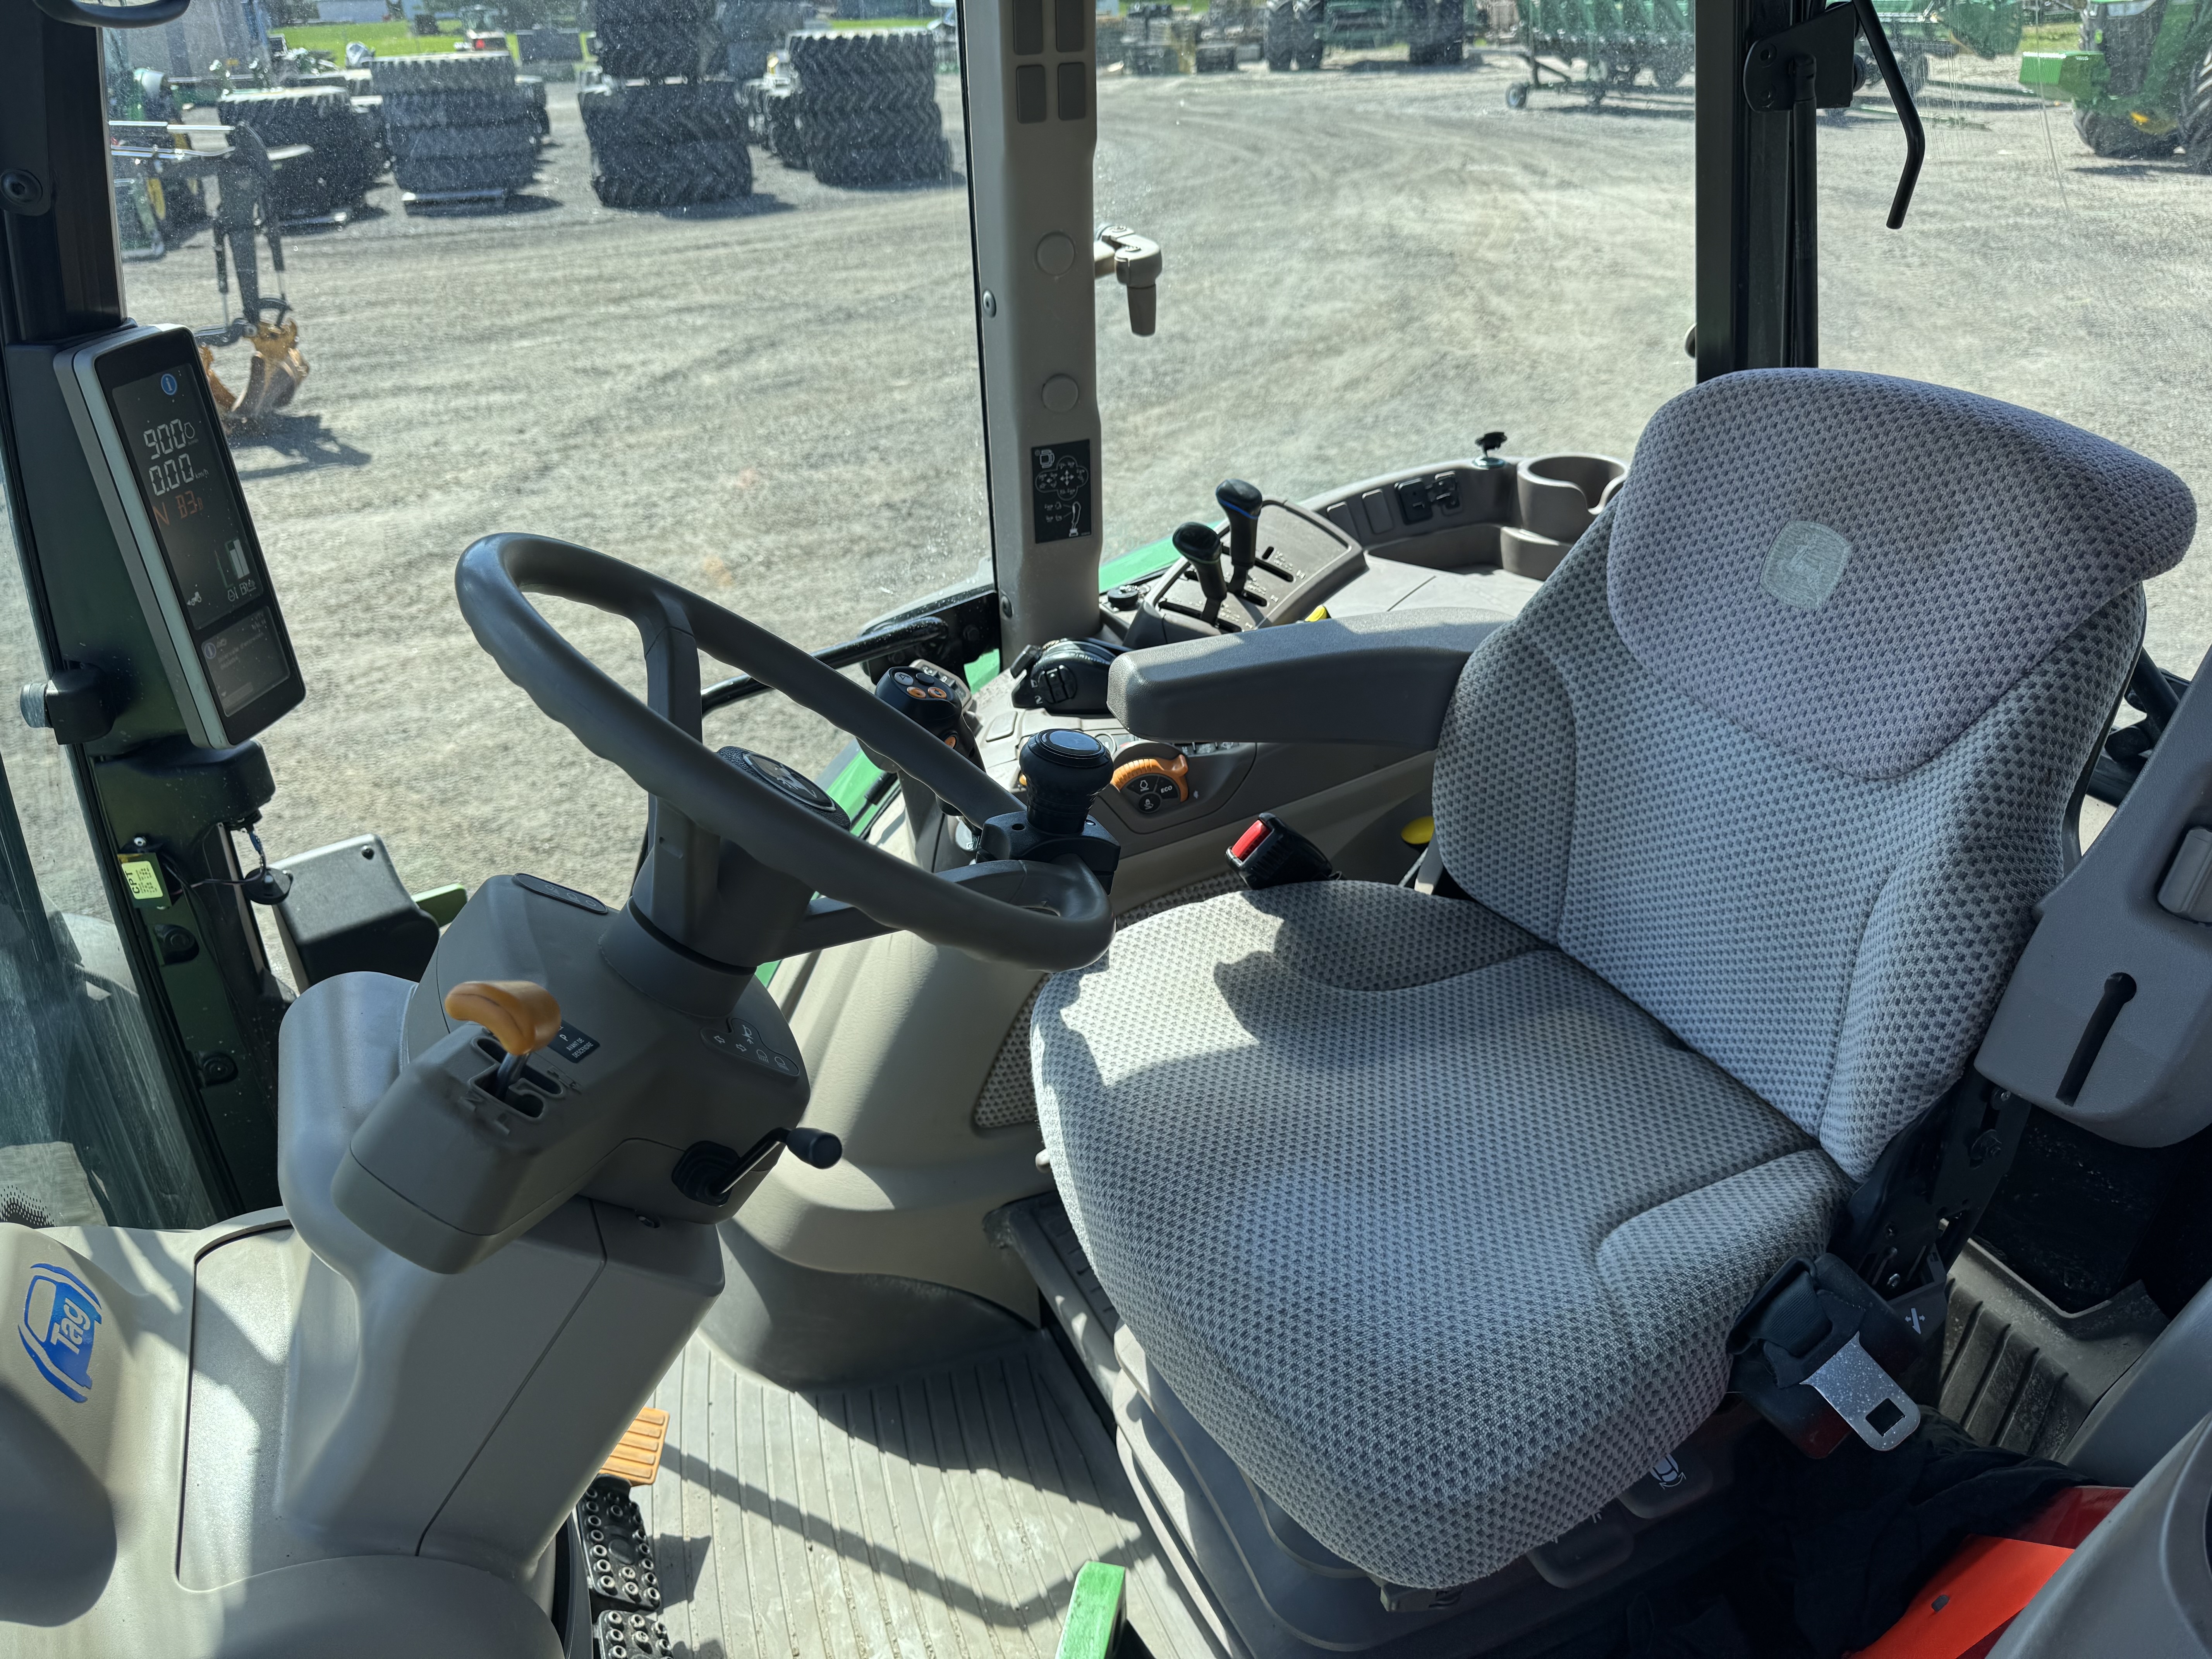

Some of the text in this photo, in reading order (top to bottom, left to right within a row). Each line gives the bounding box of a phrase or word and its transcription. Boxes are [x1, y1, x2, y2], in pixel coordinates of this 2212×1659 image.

[143, 418, 187, 460] 900
[149, 453, 194, 496] 0.00
[1160, 785, 1173, 793] ECO
[125, 870, 140, 893] CPT
[566, 1041, 579, 1051] AVANT
[50, 1298, 91, 1355] Tag
